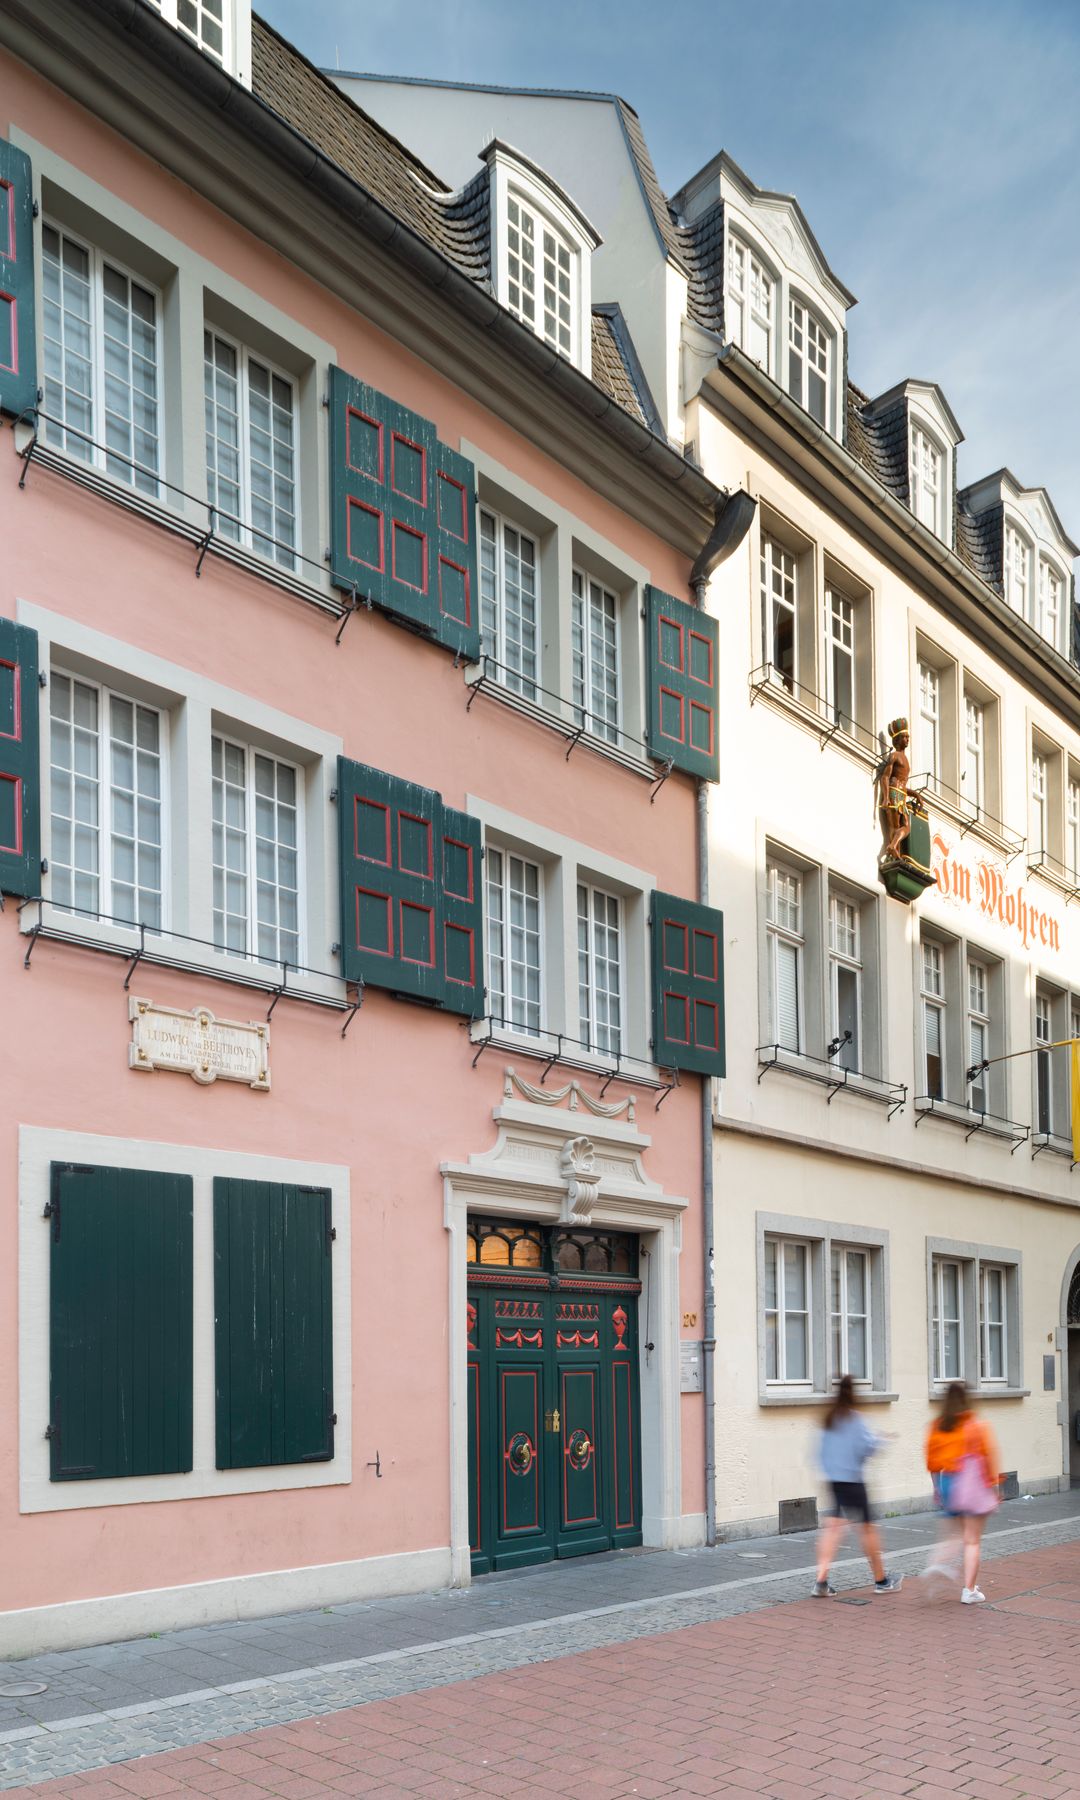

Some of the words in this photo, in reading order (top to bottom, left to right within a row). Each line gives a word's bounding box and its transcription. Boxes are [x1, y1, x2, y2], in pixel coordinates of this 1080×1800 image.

[977, 861, 1060, 953] Mohren
[147, 1029, 189, 1047] LUDWIG
[203, 1039, 257, 1059] BEETHOVEN
[683, 1313, 697, 1328] 20
